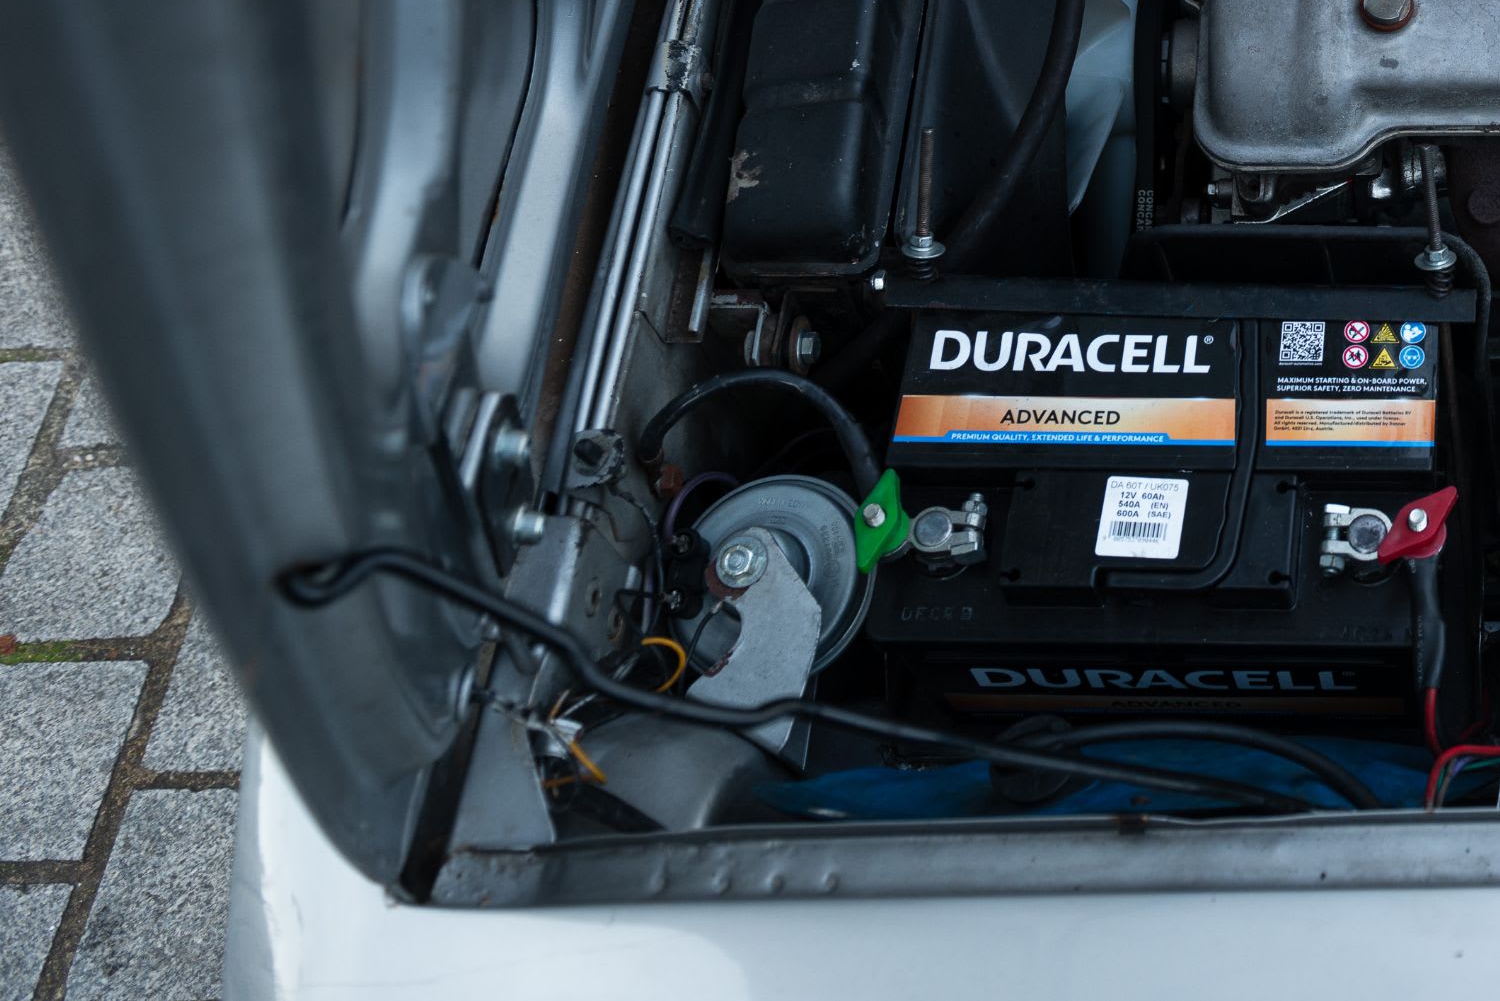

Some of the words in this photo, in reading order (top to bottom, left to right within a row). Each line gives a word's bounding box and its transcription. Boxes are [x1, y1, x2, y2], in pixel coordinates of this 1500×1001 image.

[929, 329, 1211, 374] DURACELL
[1399, 378, 1427, 386] POWER,
[1313, 385, 1341, 393] SAFETY,
[1000, 409, 1121, 426] ADVANCED
[951, 433, 990, 441] PREMIUM
[991, 433, 1029, 442] QUALITY,
[1031, 433, 1071, 441] EXTENDED
[1072, 434, 1092, 442] LIFE
[1093, 434, 1100, 442] &
[1101, 434, 1164, 442] PERFORMANCE
[1110, 481, 1124, 489] DA
[1126, 481, 1143, 490] 60T
[1150, 482, 1180, 492] UK075
[1141, 492, 1165, 501] 60Ah
[1150, 502, 1169, 510] (EN)
[1147, 511, 1172, 519] (SAE)
[969, 668, 1357, 690] DURACELL
